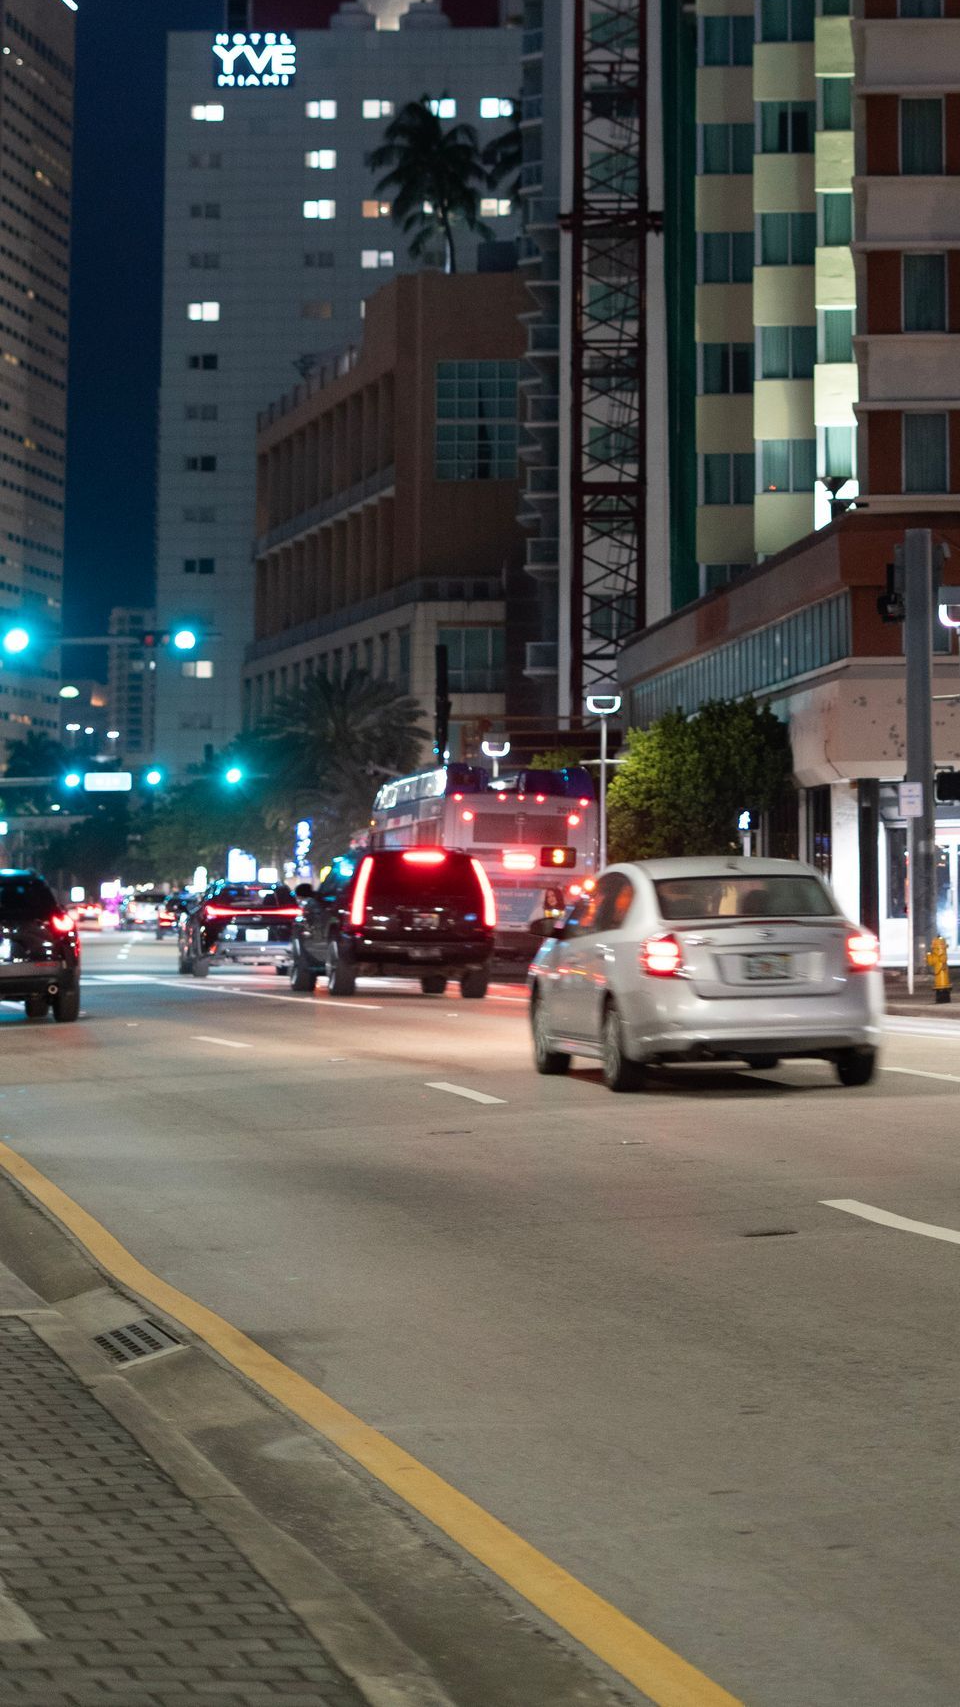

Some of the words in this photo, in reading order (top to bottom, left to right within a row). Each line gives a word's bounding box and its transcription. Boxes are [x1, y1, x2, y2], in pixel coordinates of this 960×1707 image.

[215, 33, 292, 45] HOTEL
[212, 44, 296, 74] YVE
[217, 74, 289, 86] MIAMI
